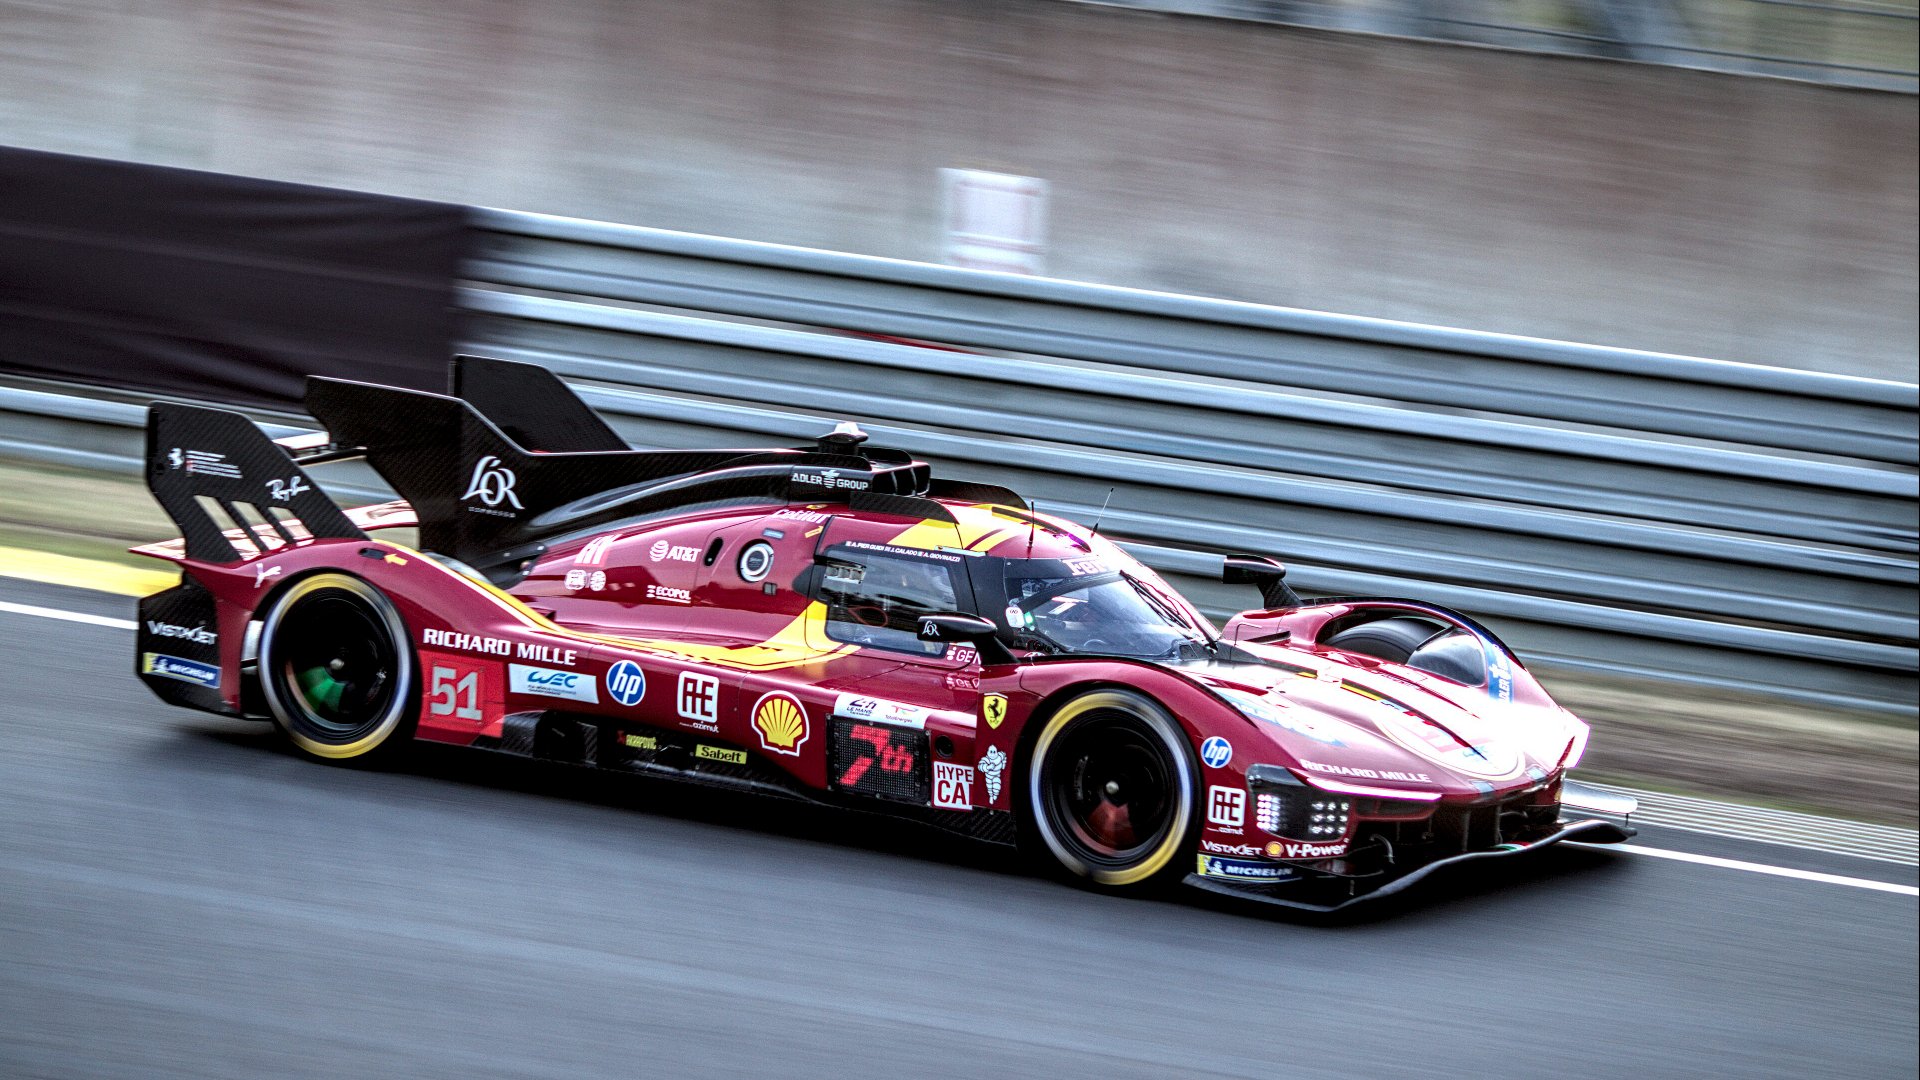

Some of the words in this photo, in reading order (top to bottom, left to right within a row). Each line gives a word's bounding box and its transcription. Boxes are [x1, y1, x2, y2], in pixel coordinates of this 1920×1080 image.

[791, 472, 822, 485] ADLER
[836, 478, 869, 491] GROUP
[666, 545, 702, 563] AT&T
[656, 586, 691, 600] ECOPOL
[422, 628, 511, 656] RICHARD
[516, 642, 578, 667] MILLE
[527, 670, 579, 689] WEC
[610, 661, 643, 706] hp
[430, 665, 484, 721] 51
[692, 720, 720, 734] azimut
[700, 746, 742, 762] Sabelt
[1204, 737, 1230, 768] hp
[936, 764, 974, 783] HYPE
[1299, 758, 1379, 779] RICHARD
[1378, 770, 1433, 783] MILLE
[937, 779, 968, 806] CA
[1285, 843, 1348, 858] V-Power
[1225, 864, 1294, 877] MICHELIN
